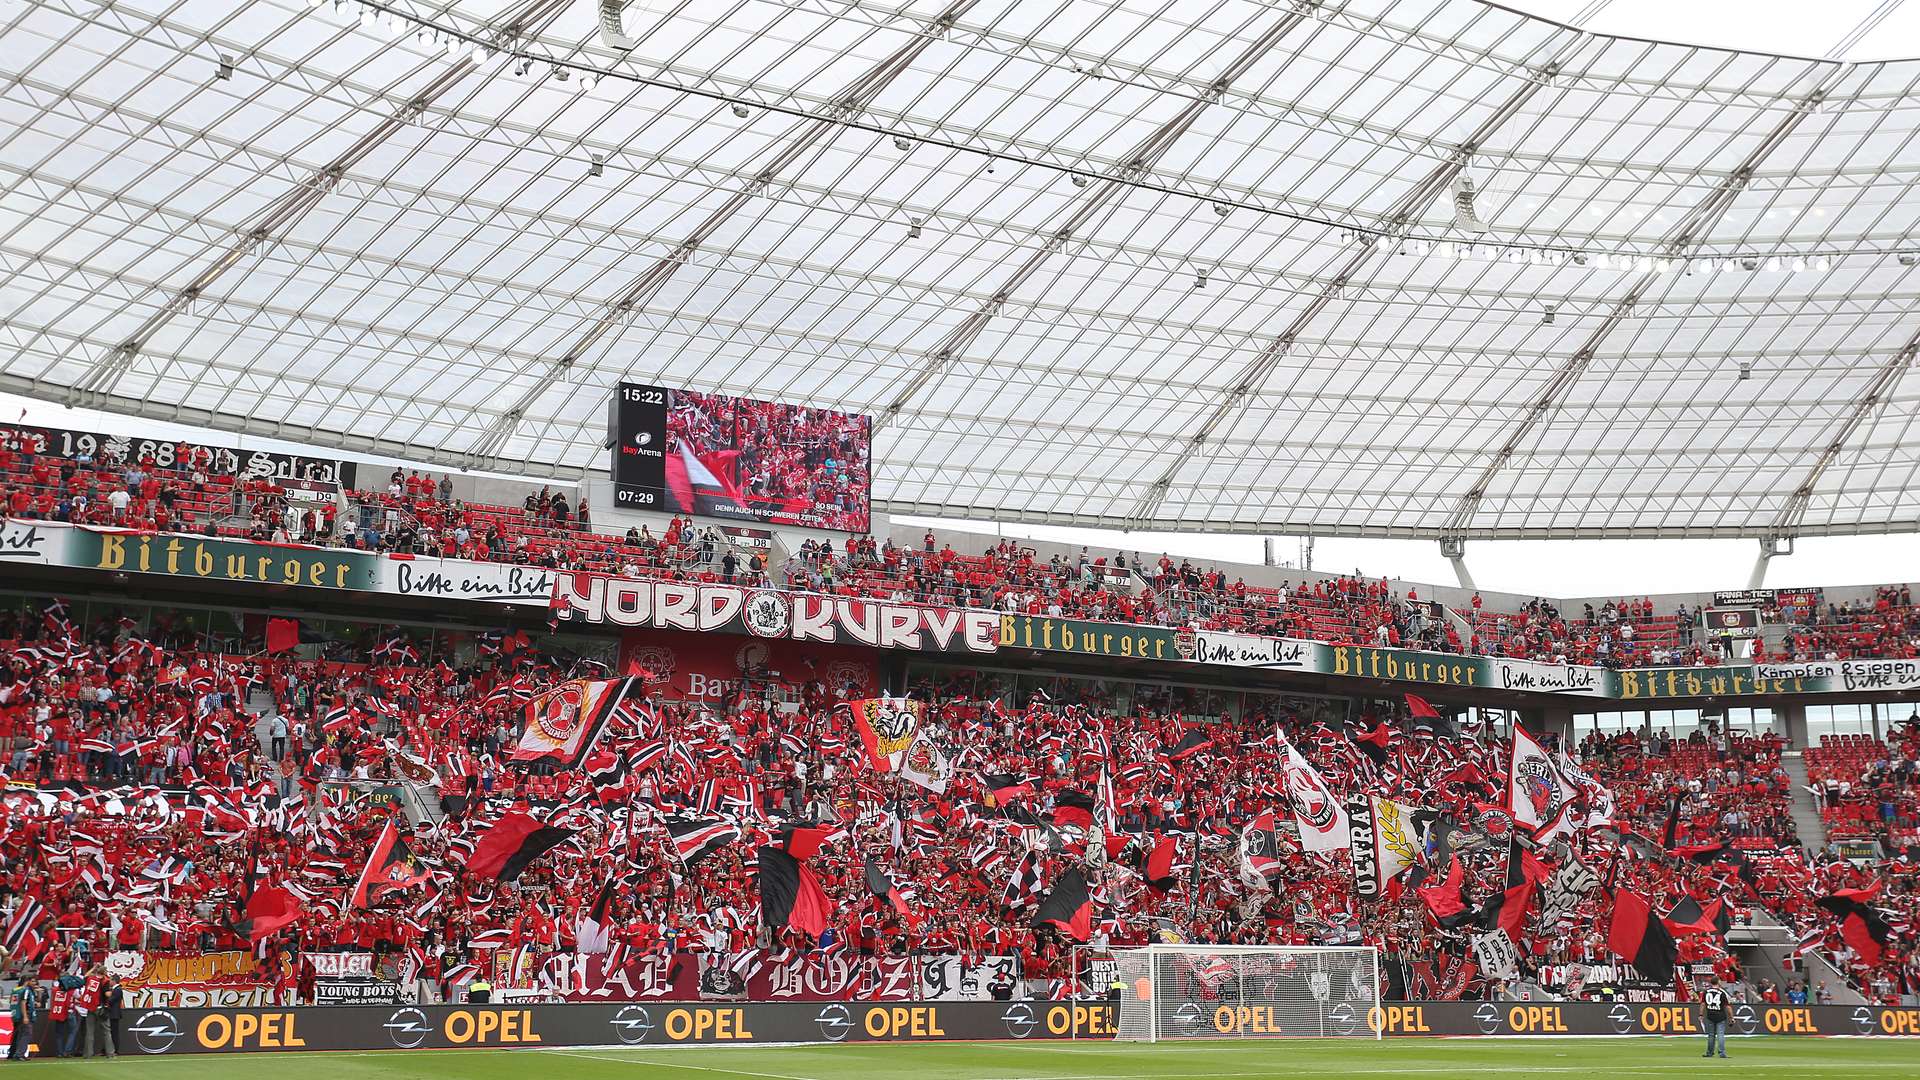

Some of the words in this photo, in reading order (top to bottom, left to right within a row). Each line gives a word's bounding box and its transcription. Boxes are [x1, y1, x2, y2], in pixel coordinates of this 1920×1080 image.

[622, 388, 664, 405] 15:22
[623, 446, 662, 458] BayArena
[316, 491, 332, 501] D9
[618, 490, 654, 504] 07:29
[714, 504, 735, 513] DENN
[735, 506, 754, 515] AUCH
[755, 508, 762, 516] IN
[762, 509, 800, 521] SCHWEREN
[753, 538, 767, 548] D8
[97, 534, 350, 589] Bitburger
[397, 563, 454, 595] Bitte
[460, 576, 502, 593] ein
[509, 567, 553, 596] Bit
[556, 573, 744, 632] NORD
[792, 598, 1000, 653] KURVE
[999, 615, 1165, 659] Bitburger
[1198, 638, 1236, 662] Bitte
[1241, 647, 1269, 661] ein
[1273, 641, 1305, 661] Bit
[1334, 647, 1476, 686] Bitburger
[1503, 665, 1536, 688] Bitte
[1540, 674, 1564, 687] ein
[1568, 667, 1594, 688] Bit
[1758, 664, 1834, 679] Kämpfen
[1620, 670, 1804, 699] Bitburger
[1092, 960, 1116, 972] WEST
[319, 986, 360, 997] YOUNG
[363, 985, 395, 996] BOYS
[1705, 992, 1721, 1008] 04
[197, 1013, 306, 1049] OPEL
[445, 1010, 542, 1044] OPEL
[665, 1008, 753, 1040] OPEL
[865, 1007, 945, 1037] OPEL
[1047, 1006, 1119, 1035] OPEL
[1214, 1005, 1282, 1034] OPEL
[1367, 1006, 1431, 1033] OPEL
[1509, 1006, 1569, 1033] OPEL
[1641, 1007, 1697, 1033] OPEL
[1764, 1008, 1818, 1034] OPEL
